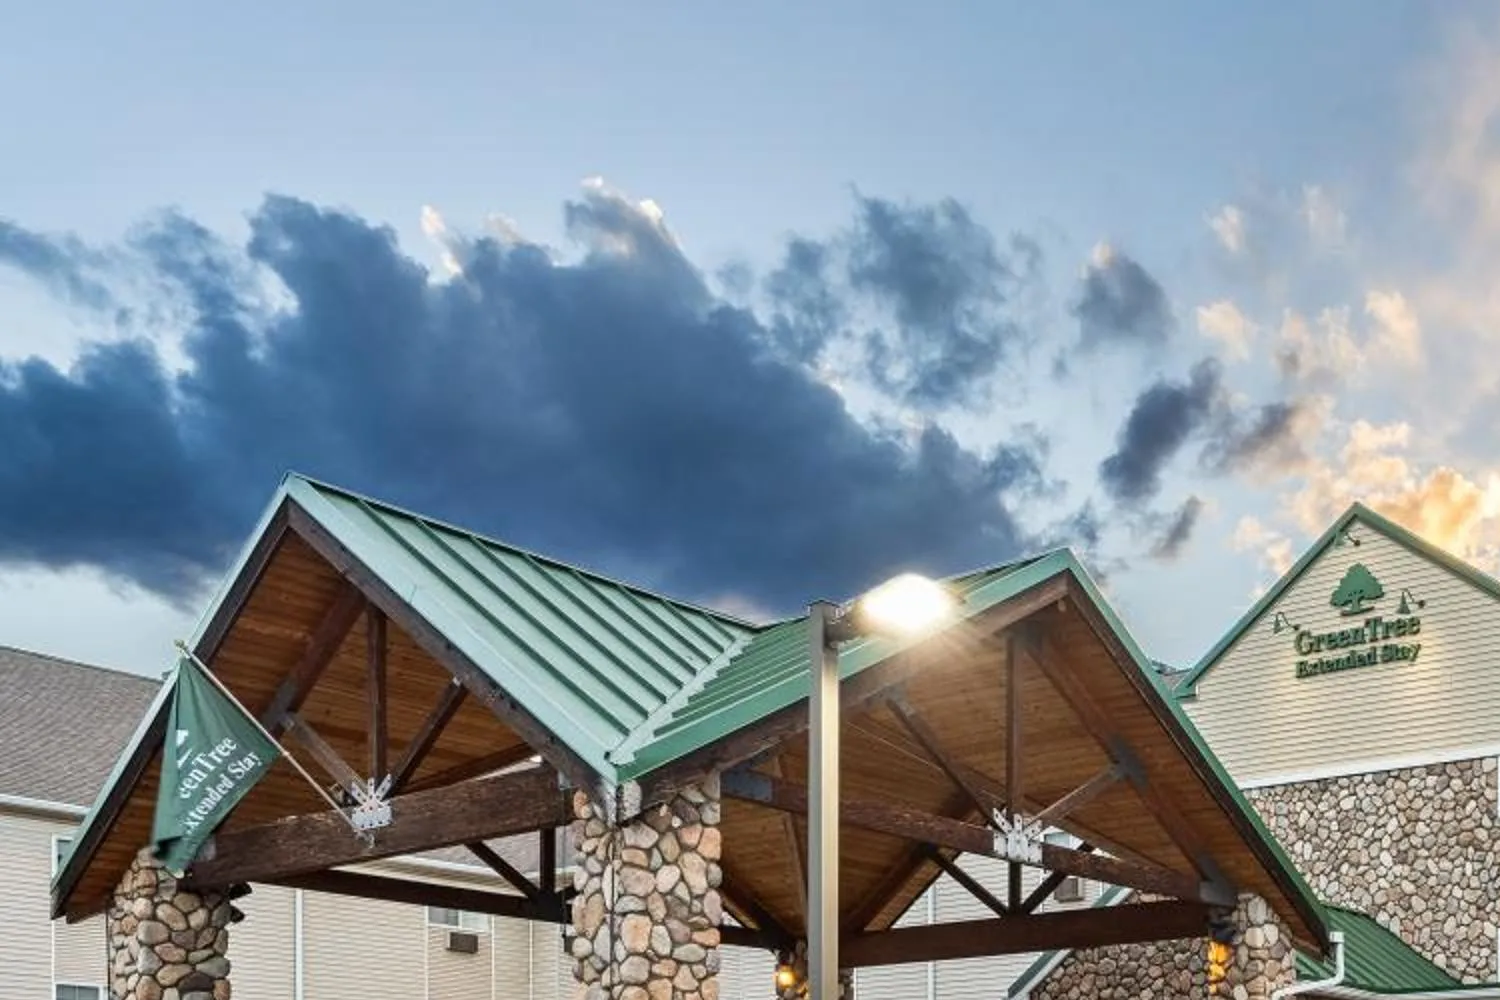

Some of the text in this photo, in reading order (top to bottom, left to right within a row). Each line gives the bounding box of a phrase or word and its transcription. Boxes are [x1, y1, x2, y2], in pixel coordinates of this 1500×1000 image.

[1294, 616, 1421, 656] GreenTree
[1295, 643, 1422, 678] Extended Stay
[179, 737, 237, 799] eenTree
[184, 773, 235, 834] xtended
